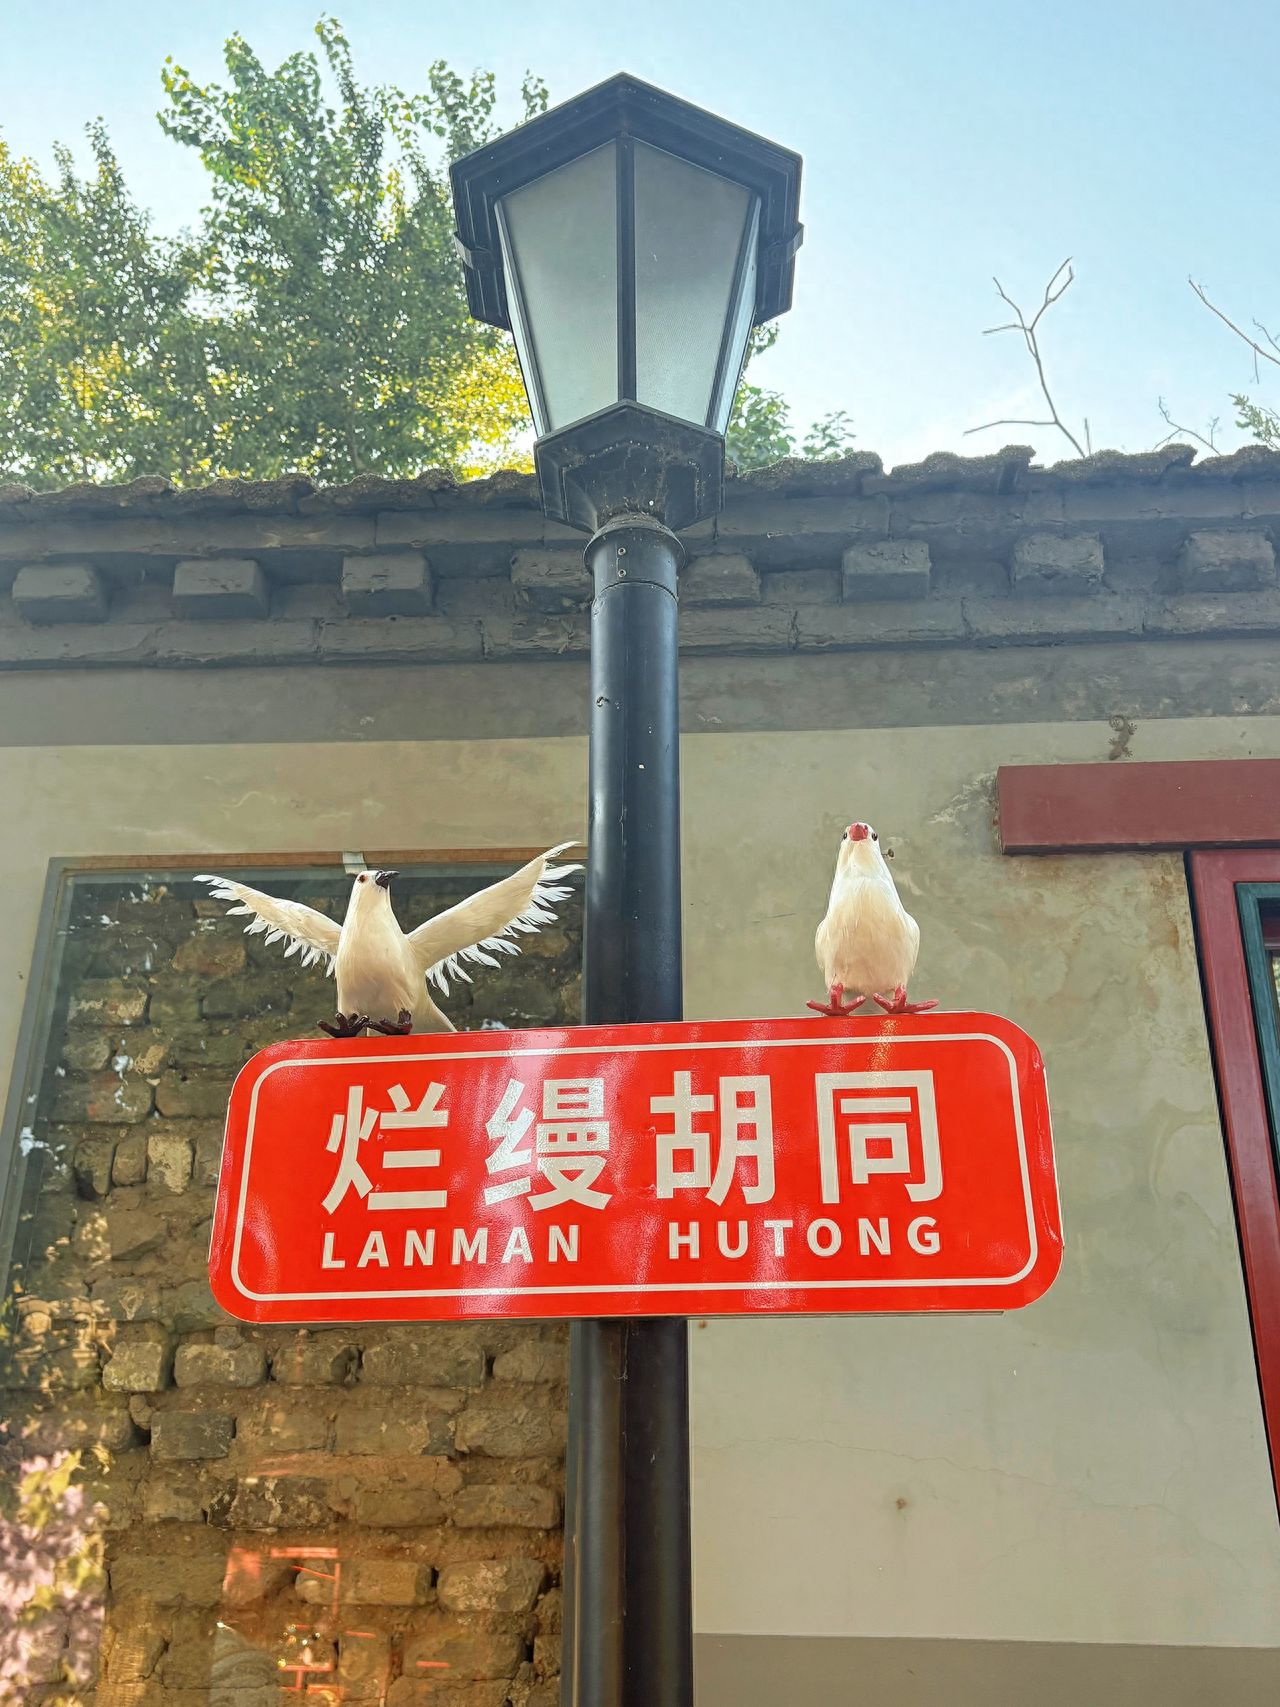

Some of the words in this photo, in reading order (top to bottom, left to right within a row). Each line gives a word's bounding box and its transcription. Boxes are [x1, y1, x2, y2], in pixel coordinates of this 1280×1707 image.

[322, 1069, 943, 1215] 烂缦胡同
[322, 1225, 579, 1269] LANMAN
[668, 1217, 941, 1260] HUTONG
